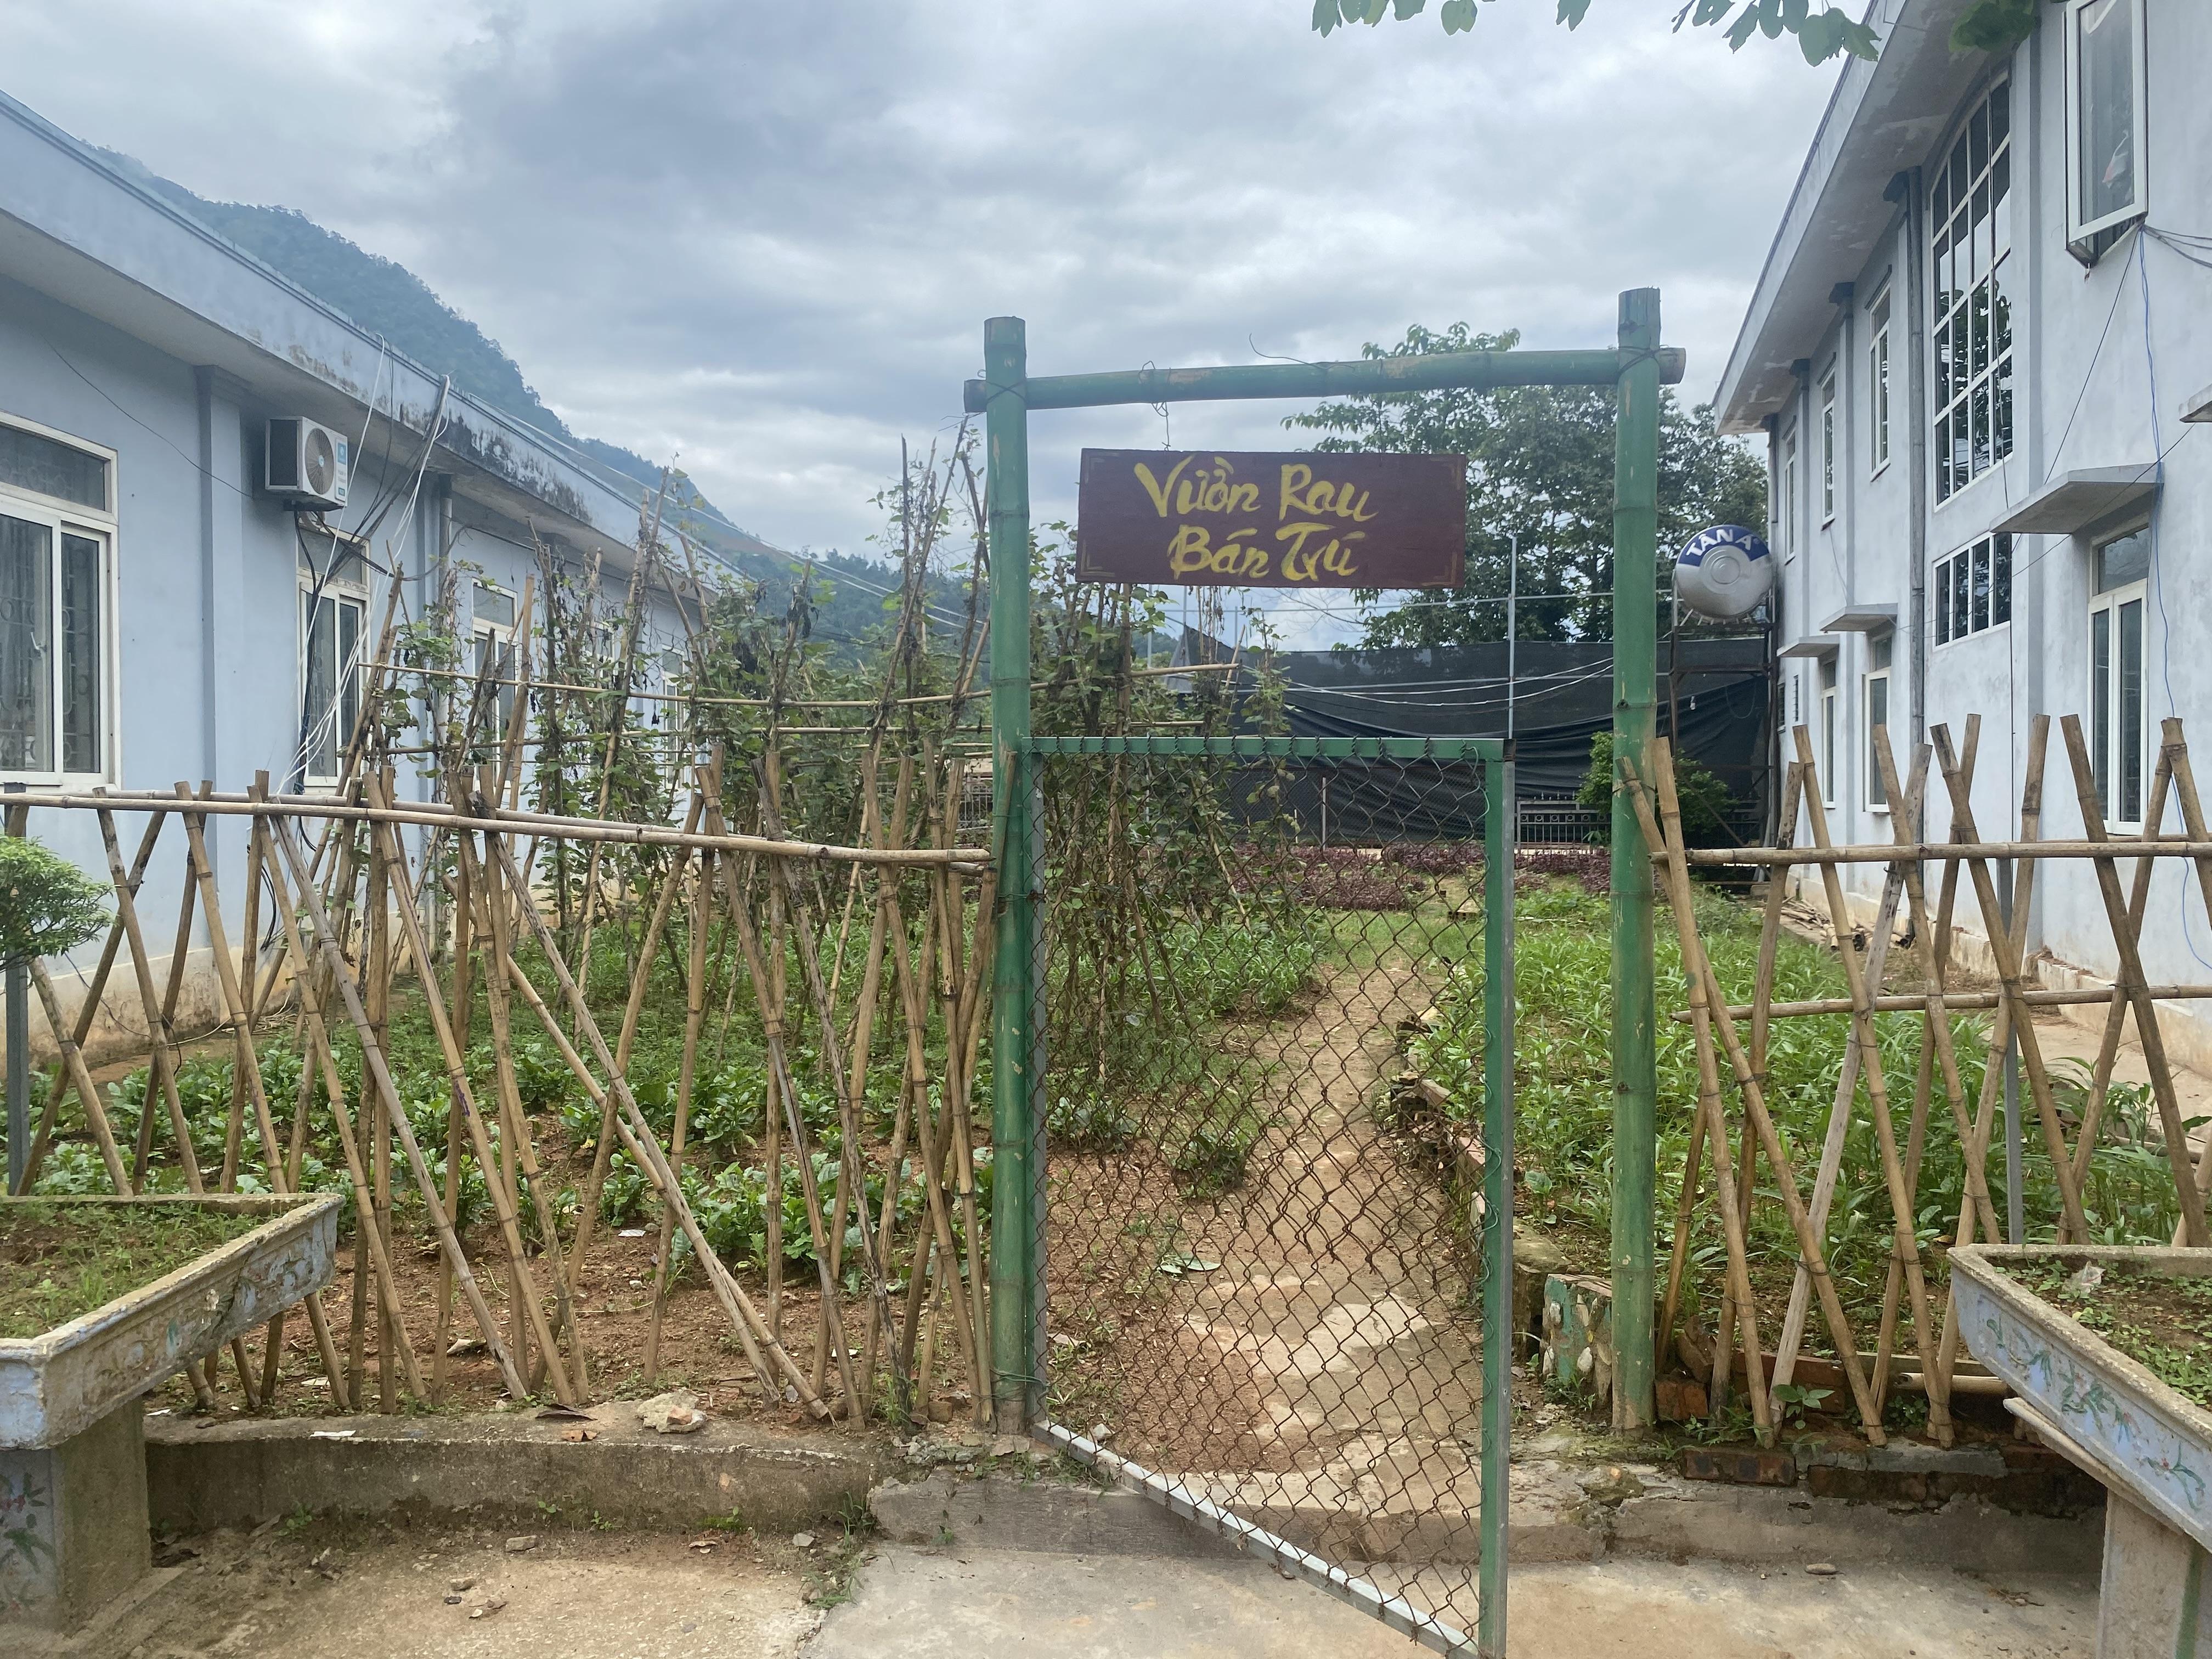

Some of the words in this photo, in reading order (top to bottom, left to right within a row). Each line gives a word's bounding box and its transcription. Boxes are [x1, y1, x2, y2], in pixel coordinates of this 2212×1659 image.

[1134, 454, 1261, 517] Vườn
[1279, 464, 1379, 522] Rau
[1167, 524, 1269, 580] Bán
[1275, 522, 1365, 582] Trú
